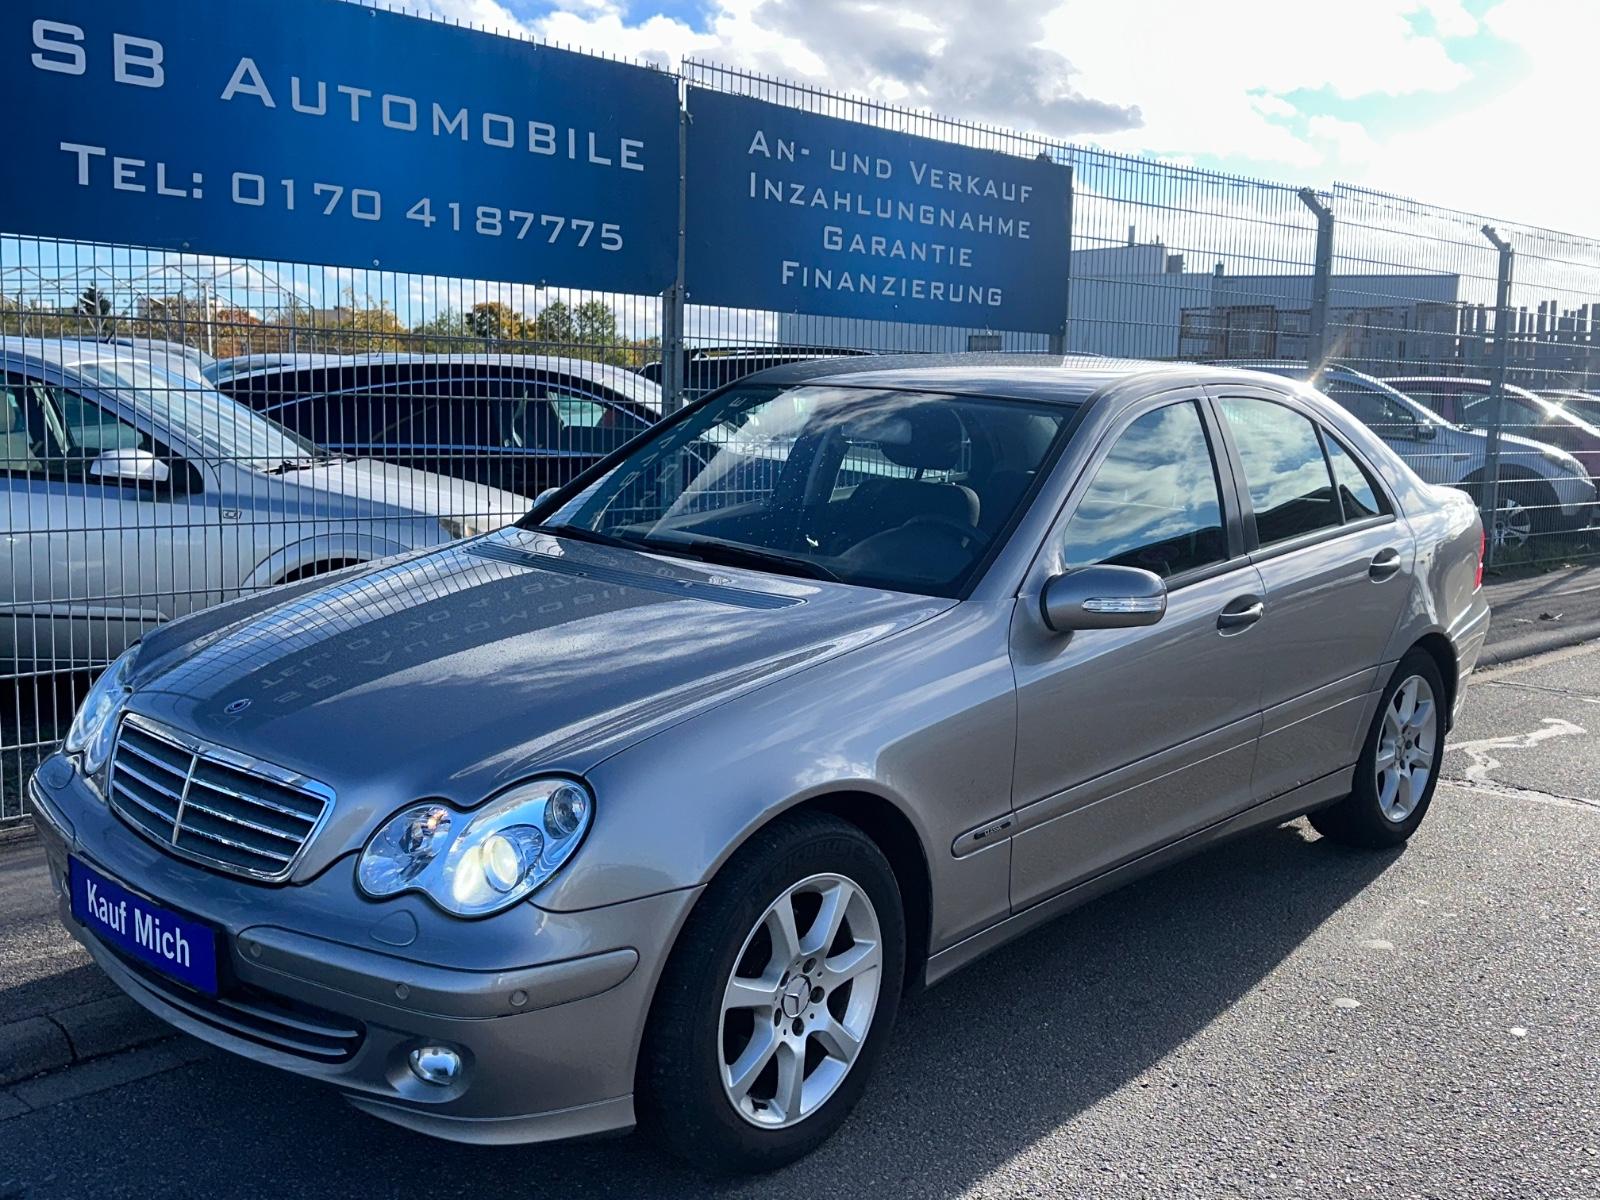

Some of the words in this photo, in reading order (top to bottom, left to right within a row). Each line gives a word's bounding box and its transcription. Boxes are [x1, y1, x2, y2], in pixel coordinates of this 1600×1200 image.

[31, 19, 165, 88] SB
[220, 57, 645, 172] AUTOMOBILE
[60, 141, 204, 199] TEL:
[231, 171, 381, 222] 0170
[406, 197, 624, 251] 4187775
[748, 130, 811, 162] AN-
[830, 149, 893, 179] UND
[909, 161, 1034, 204] VERKAUF
[750, 171, 1031, 240] INZAHLUNGNAHME
[782, 260, 1003, 306] FINANZIERUNG
[823, 225, 974, 268] GARANTIE
[86, 880, 126, 935] Kauf
[134, 908, 190, 967] Mich
